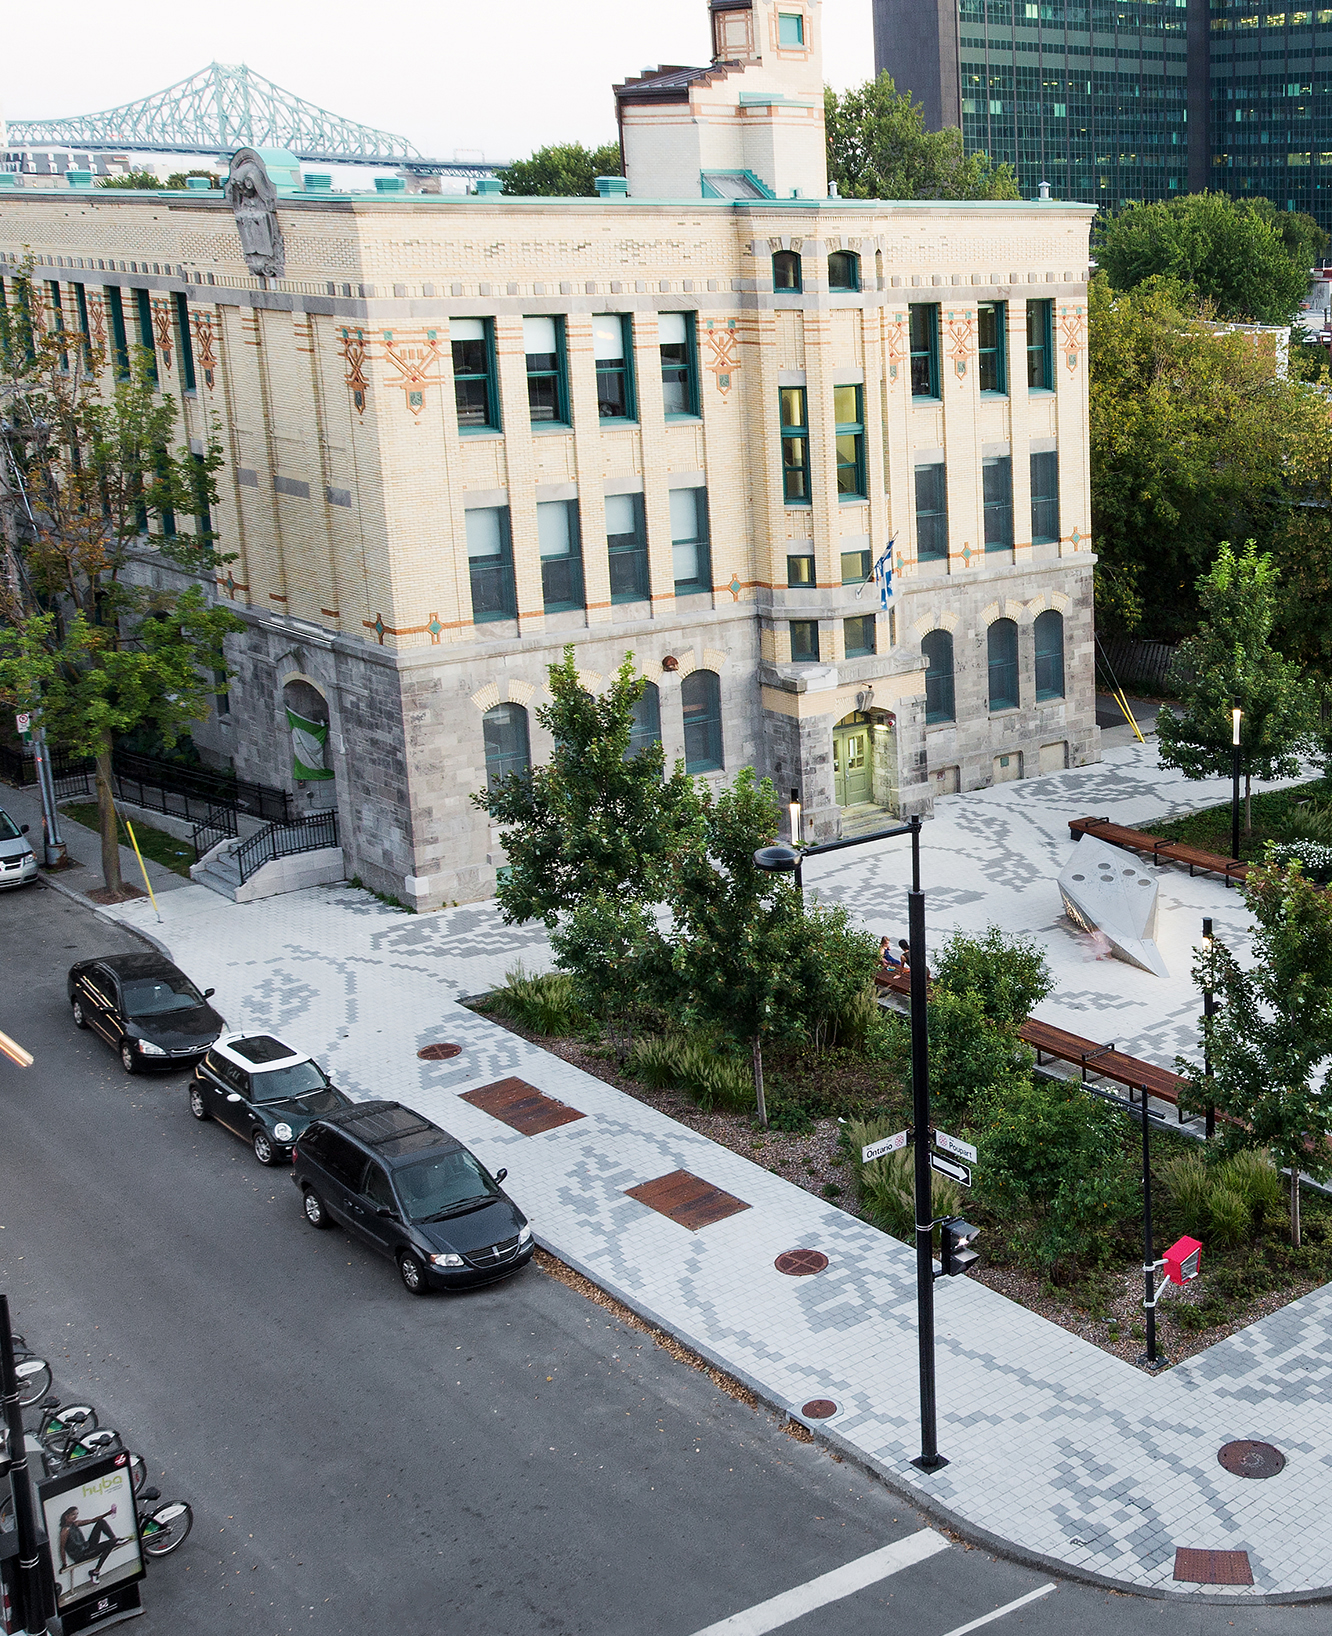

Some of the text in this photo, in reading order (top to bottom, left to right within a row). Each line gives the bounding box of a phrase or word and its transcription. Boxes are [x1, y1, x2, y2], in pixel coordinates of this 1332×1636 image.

[866, 1143, 893, 1159] Ontario
[949, 1141, 973, 1159] Poupart
[82, 1475, 123, 1498] hyba
